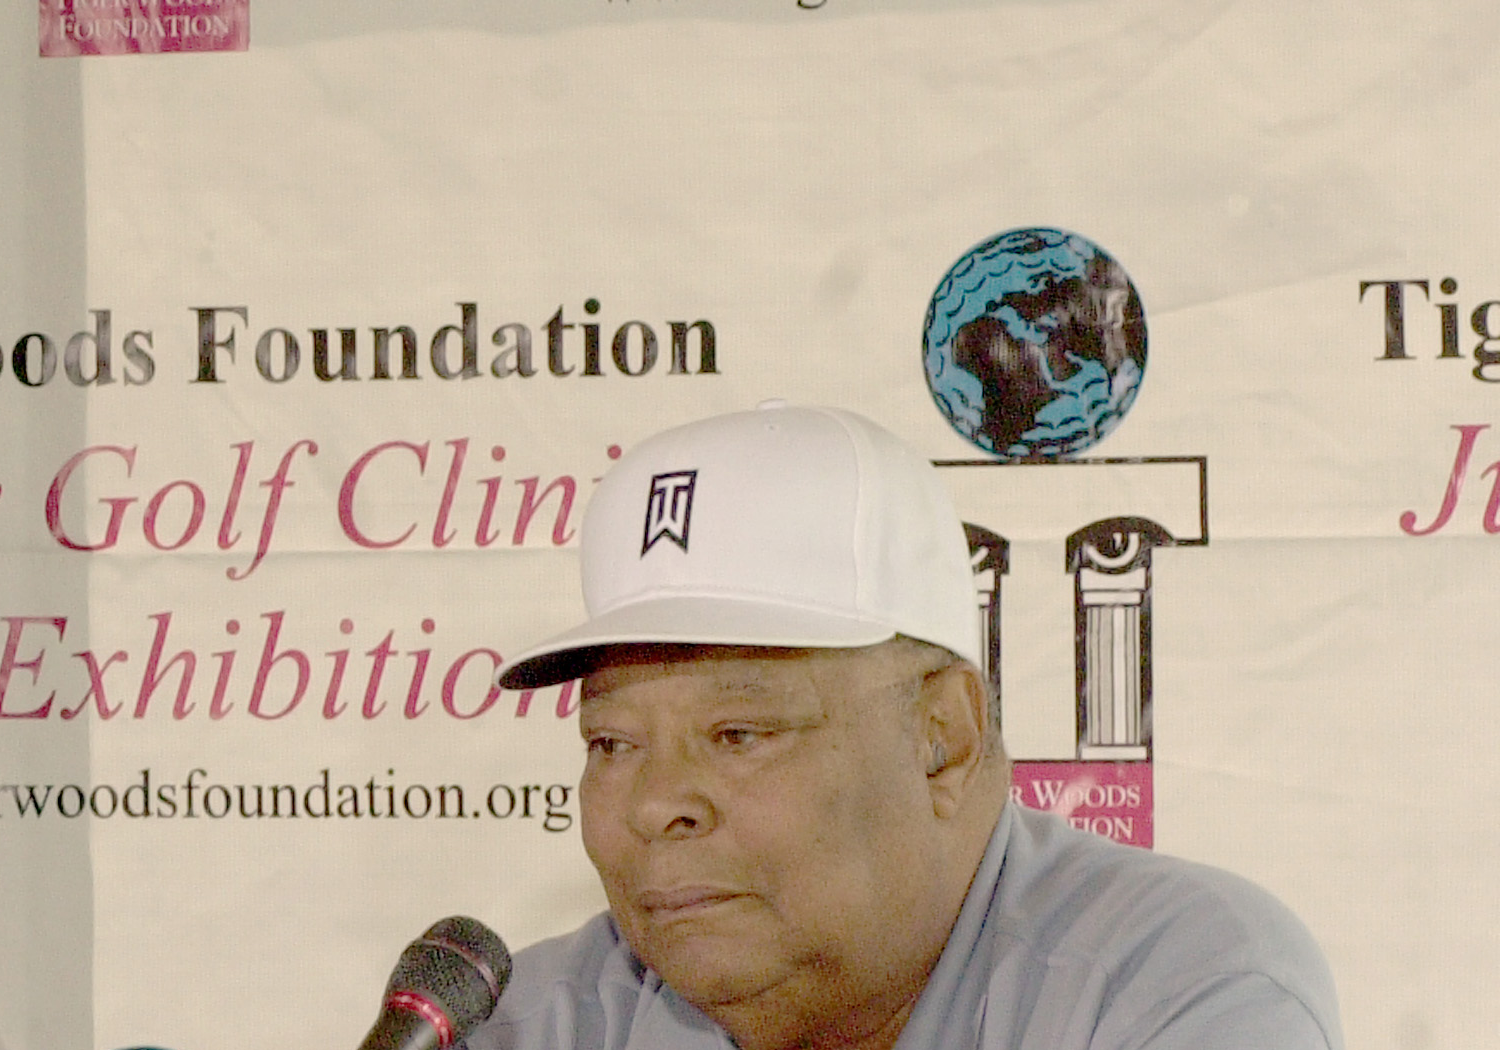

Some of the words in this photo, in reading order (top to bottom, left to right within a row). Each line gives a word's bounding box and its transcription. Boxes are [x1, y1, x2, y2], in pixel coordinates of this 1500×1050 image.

[188, 297, 721, 384] Foundation
[1358, 276, 1500, 384] Tig
[45, 439, 318, 581] Golf
[336, 437, 622, 549] Clin
[1031, 779, 1141, 808] WOODS
